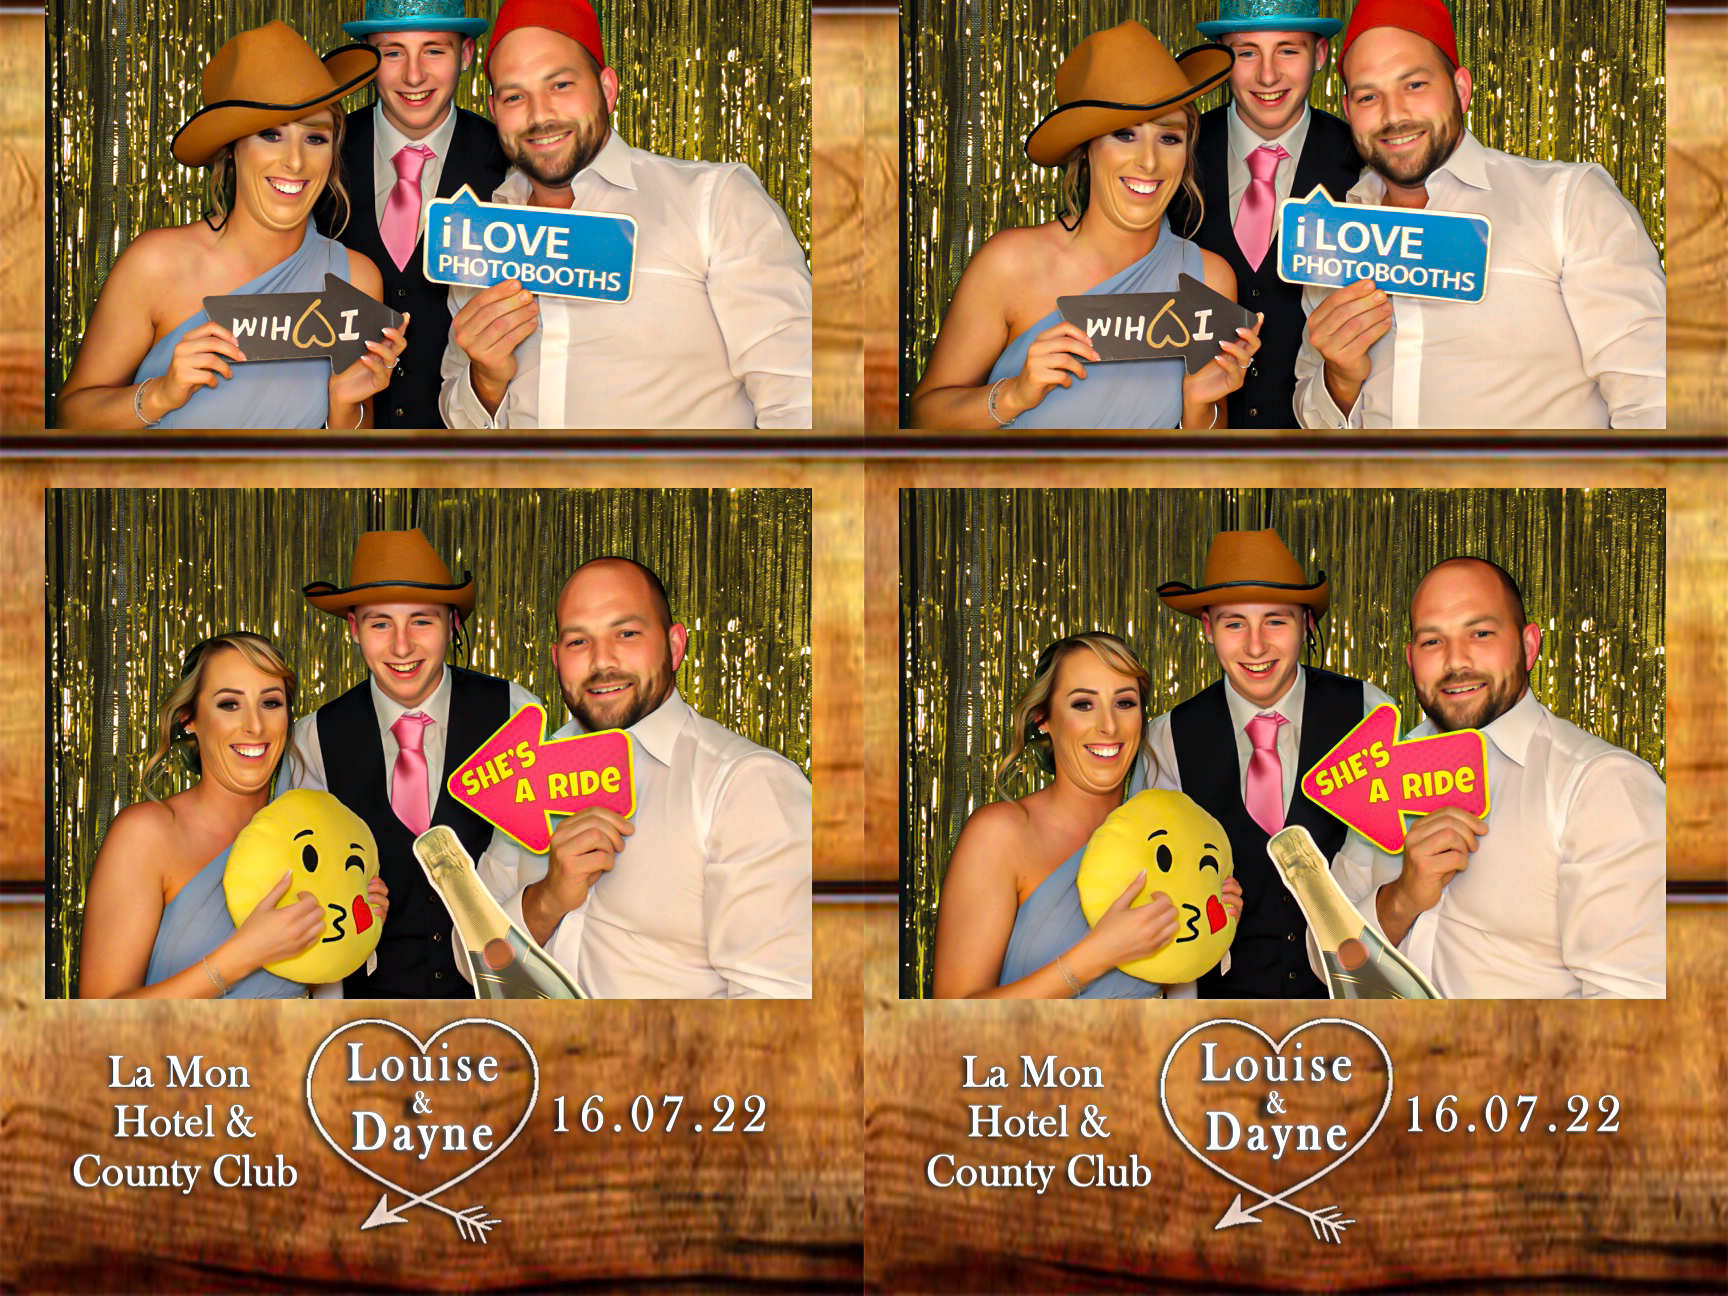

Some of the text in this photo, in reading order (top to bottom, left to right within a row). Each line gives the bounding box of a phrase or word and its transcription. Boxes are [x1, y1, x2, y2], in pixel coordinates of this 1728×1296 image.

[442, 216, 571, 260] i LOVE
[1296, 216, 1425, 260] i LOVE
[438, 254, 622, 292] PHOTOBOOTHS
[1292, 254, 1476, 292] PHOTOBOOTHS
[338, 308, 360, 341] I
[1192, 308, 1214, 341] I
[461, 741, 536, 796] SHE'S
[1315, 741, 1390, 796] SHE'S
[515, 777, 536, 803] A
[1369, 777, 1390, 803] A
